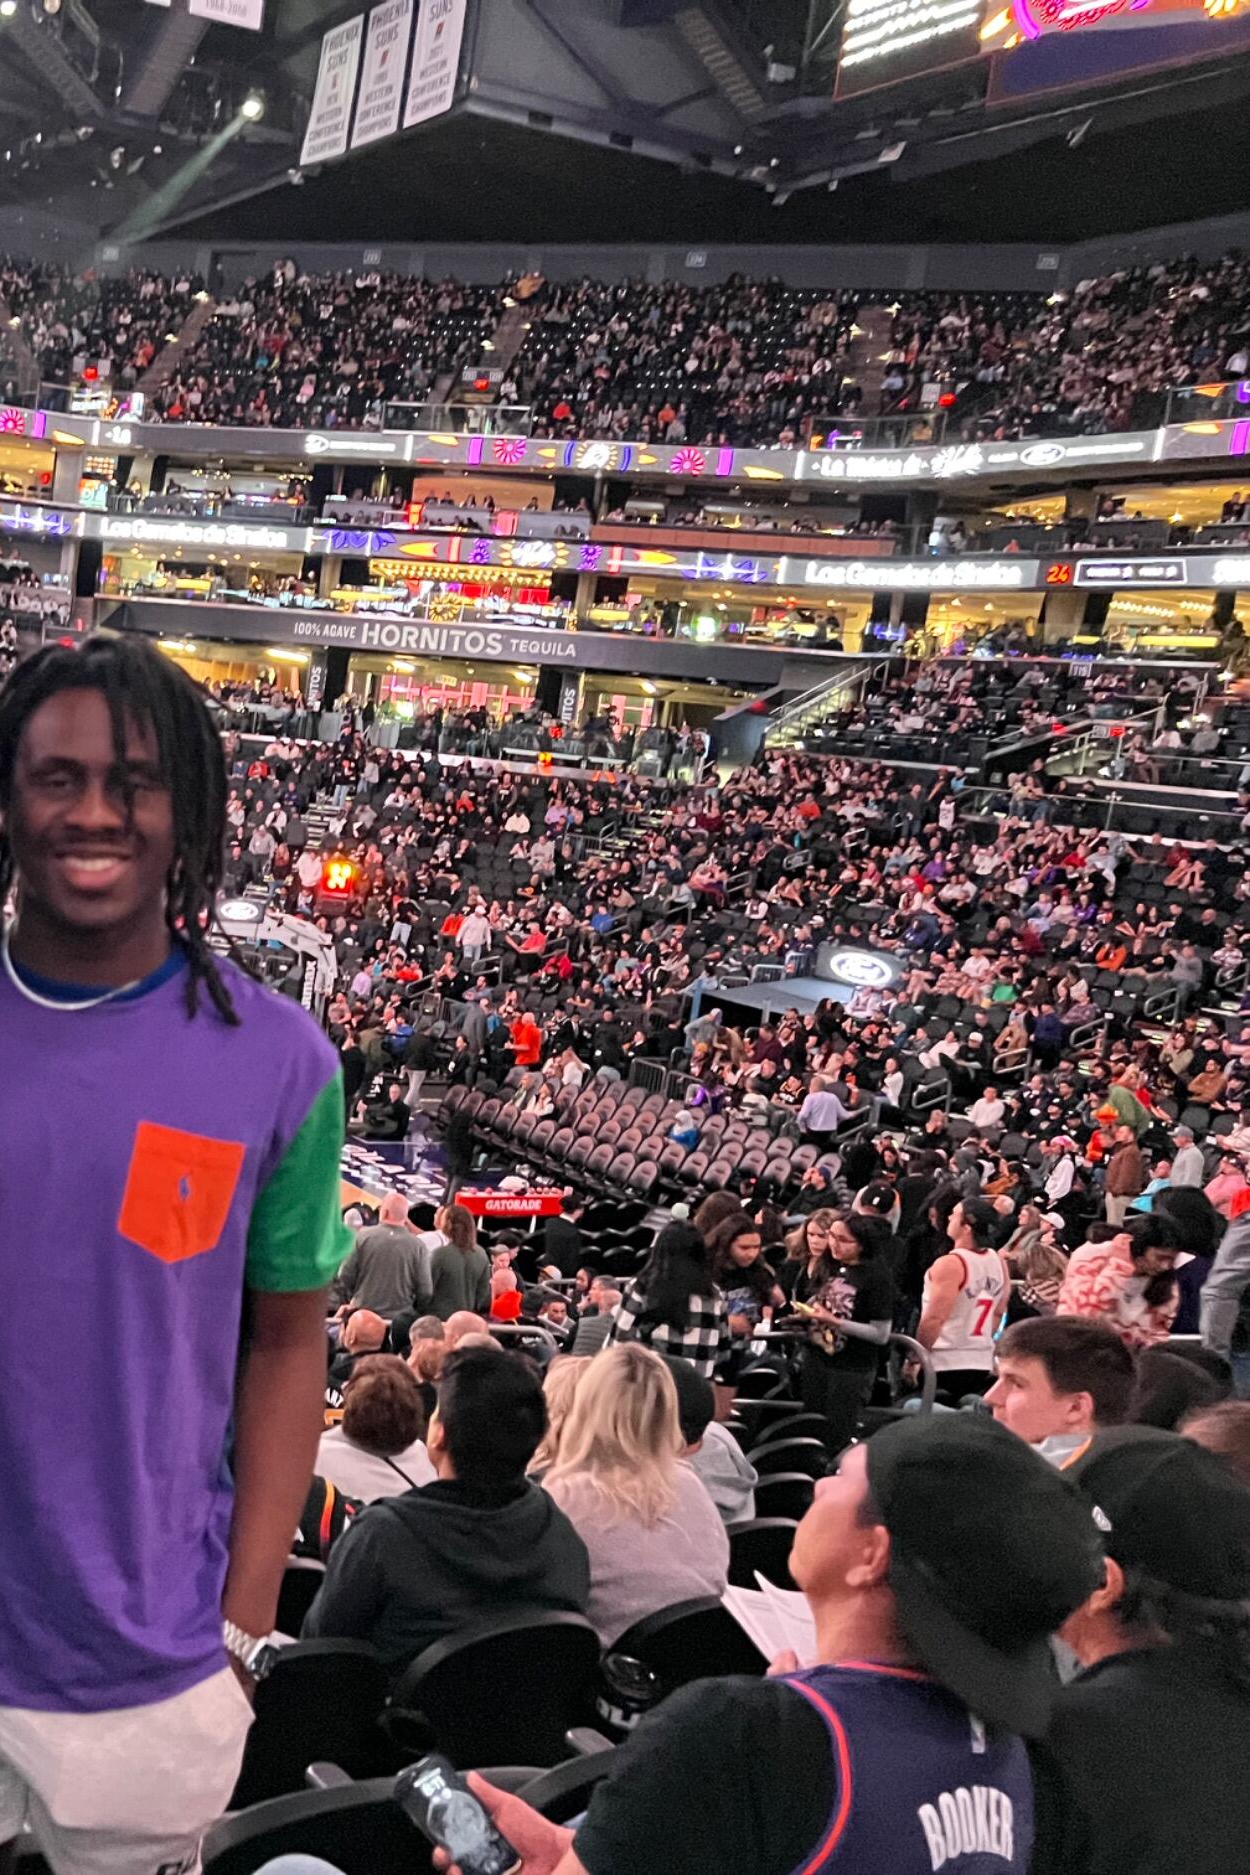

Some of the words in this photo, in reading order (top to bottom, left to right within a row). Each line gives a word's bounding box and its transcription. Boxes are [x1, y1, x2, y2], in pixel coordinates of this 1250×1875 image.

[375, 23, 399, 49] SUNS
[293, 622, 321, 637] 100%
[322, 624, 356, 639] AGAVE
[361, 622, 503, 656] HORNITOS
[510, 639, 577, 658] TEQUILA
[485, 1199, 542, 1211] GATORADE
[971, 1298, 994, 1336] 7
[917, 1784, 1014, 1872] BOOKER
